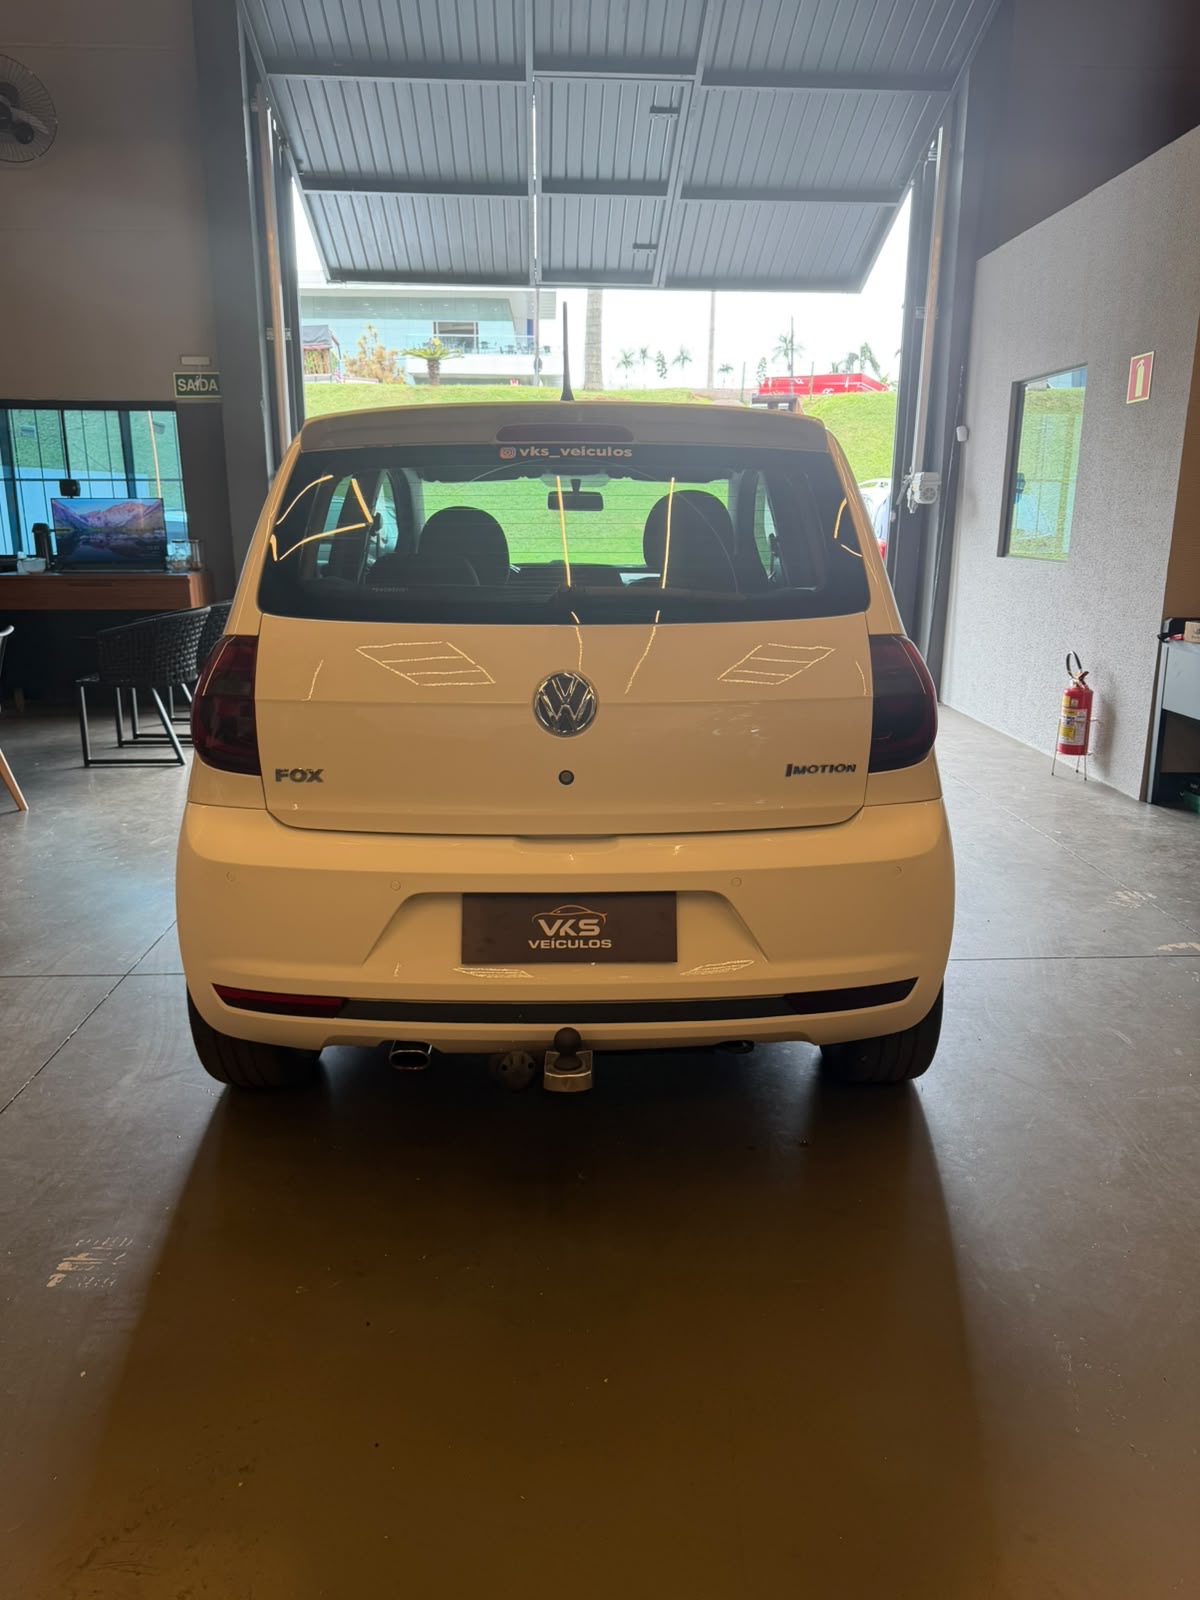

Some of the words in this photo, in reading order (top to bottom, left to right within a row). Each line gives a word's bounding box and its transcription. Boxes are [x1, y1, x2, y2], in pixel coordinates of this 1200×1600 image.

[275, 768, 324, 783] FOX
[537, 919, 601, 936] VKS
[528, 937, 612, 949] VEÍCULOS
